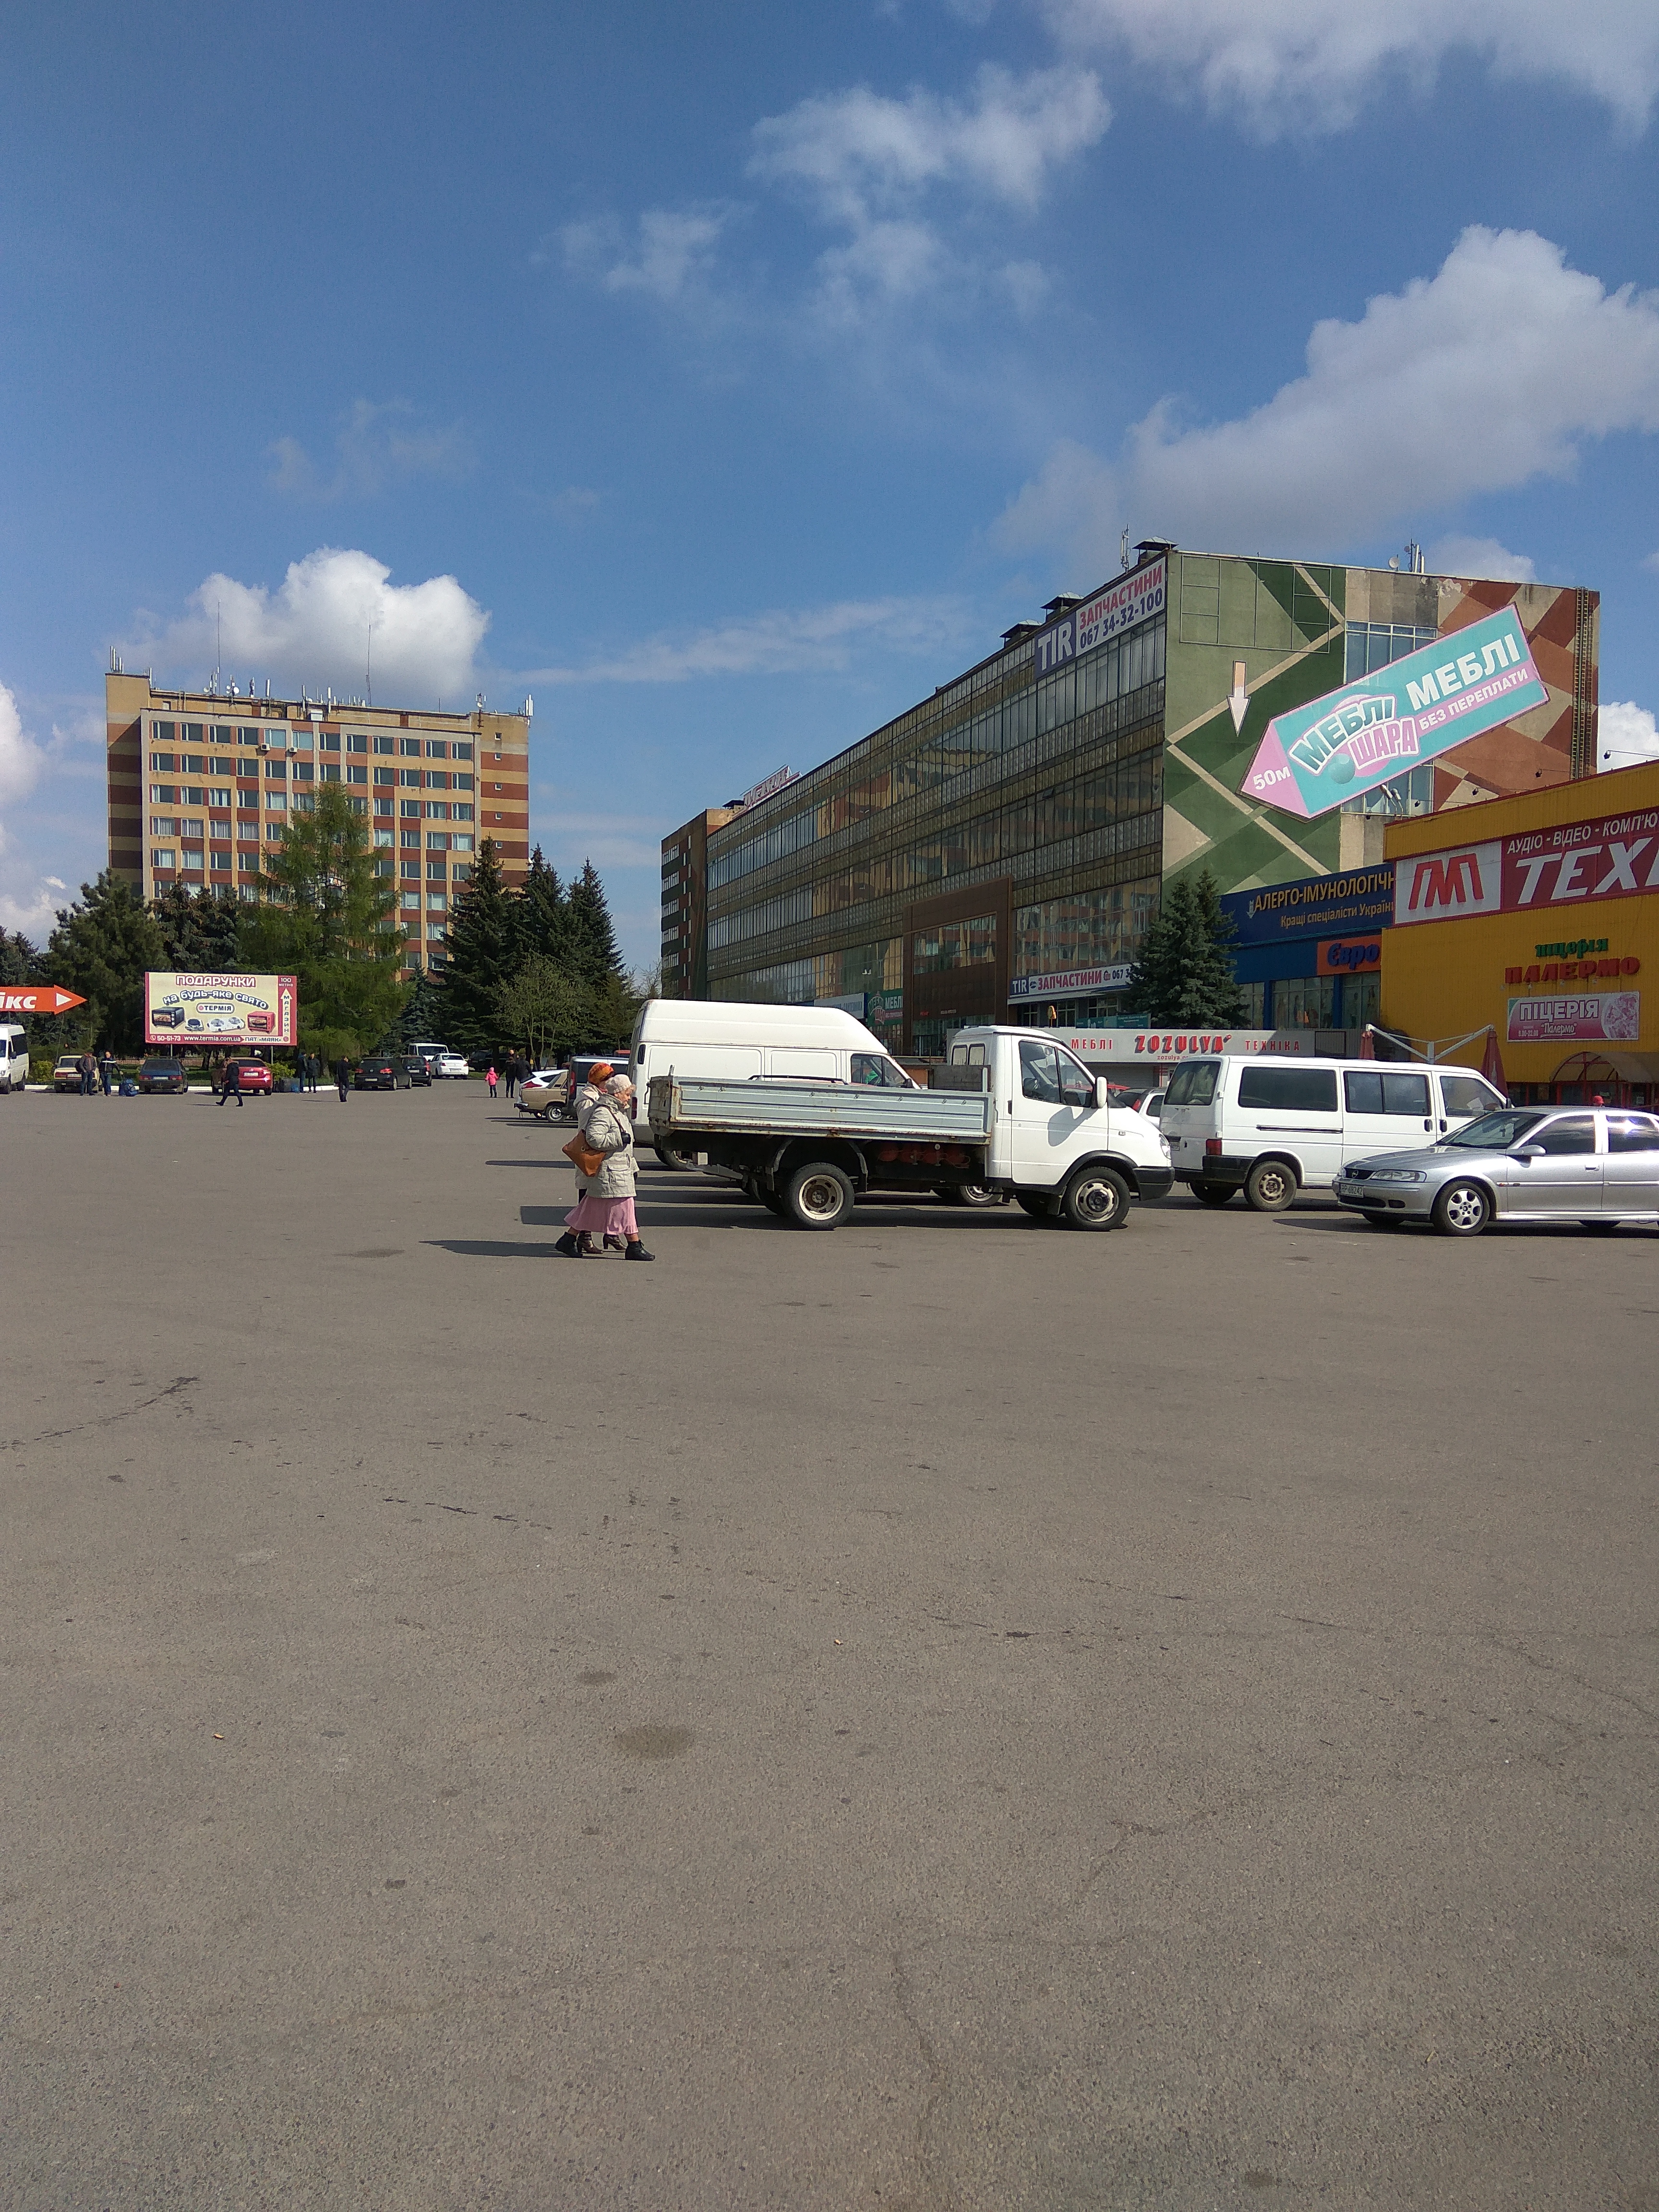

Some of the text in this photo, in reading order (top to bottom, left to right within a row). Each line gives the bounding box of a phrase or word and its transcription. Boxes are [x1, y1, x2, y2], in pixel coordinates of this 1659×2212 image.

[1080, 565, 1162, 630] ЗАПЧАСТИНИ
[1081, 588, 1163, 649] 067 34-32-100
[1038, 621, 1073, 671] TIR
[1406, 634, 1521, 711] МЕБЛІ
[1419, 668, 1528, 730] БЕЗ ПЕРЕПЛАТИ
[1289, 696, 1395, 774] МЕБЛІ
[1347, 718, 1419, 770] ШАРА
[1507, 835, 1543, 855] АУДІО
[1552, 825, 1591, 848] ВІДЕО
[1602, 812, 1659, 837] КОМП'Ю
[1281, 912, 1306, 929] Кращі
[1307, 906, 1358, 923] спеціалісти
[1327, 942, 1380, 971] Євро
[1535, 938, 1609, 959] піцерія
[176, 975, 255, 987] ПОДАРУНКИ
[1037, 970, 1103, 990] ЗАПЧАСТИНИ
[1112, 970, 1123, 980] 067
[1504, 957, 1641, 984] ПАЛЕРМО
[1012, 979, 1028, 993] TIR
[163, 990, 269, 1010] на будь-яке свято
[1520, 999, 1599, 1023] ПІЦЕРІЯ
[1071, 1039, 1113, 1049] МЕБЛІ
[1134, 1034, 1224, 1054] ZOZULYA
[1245, 1040, 1300, 1051] ТЕХНІКА
